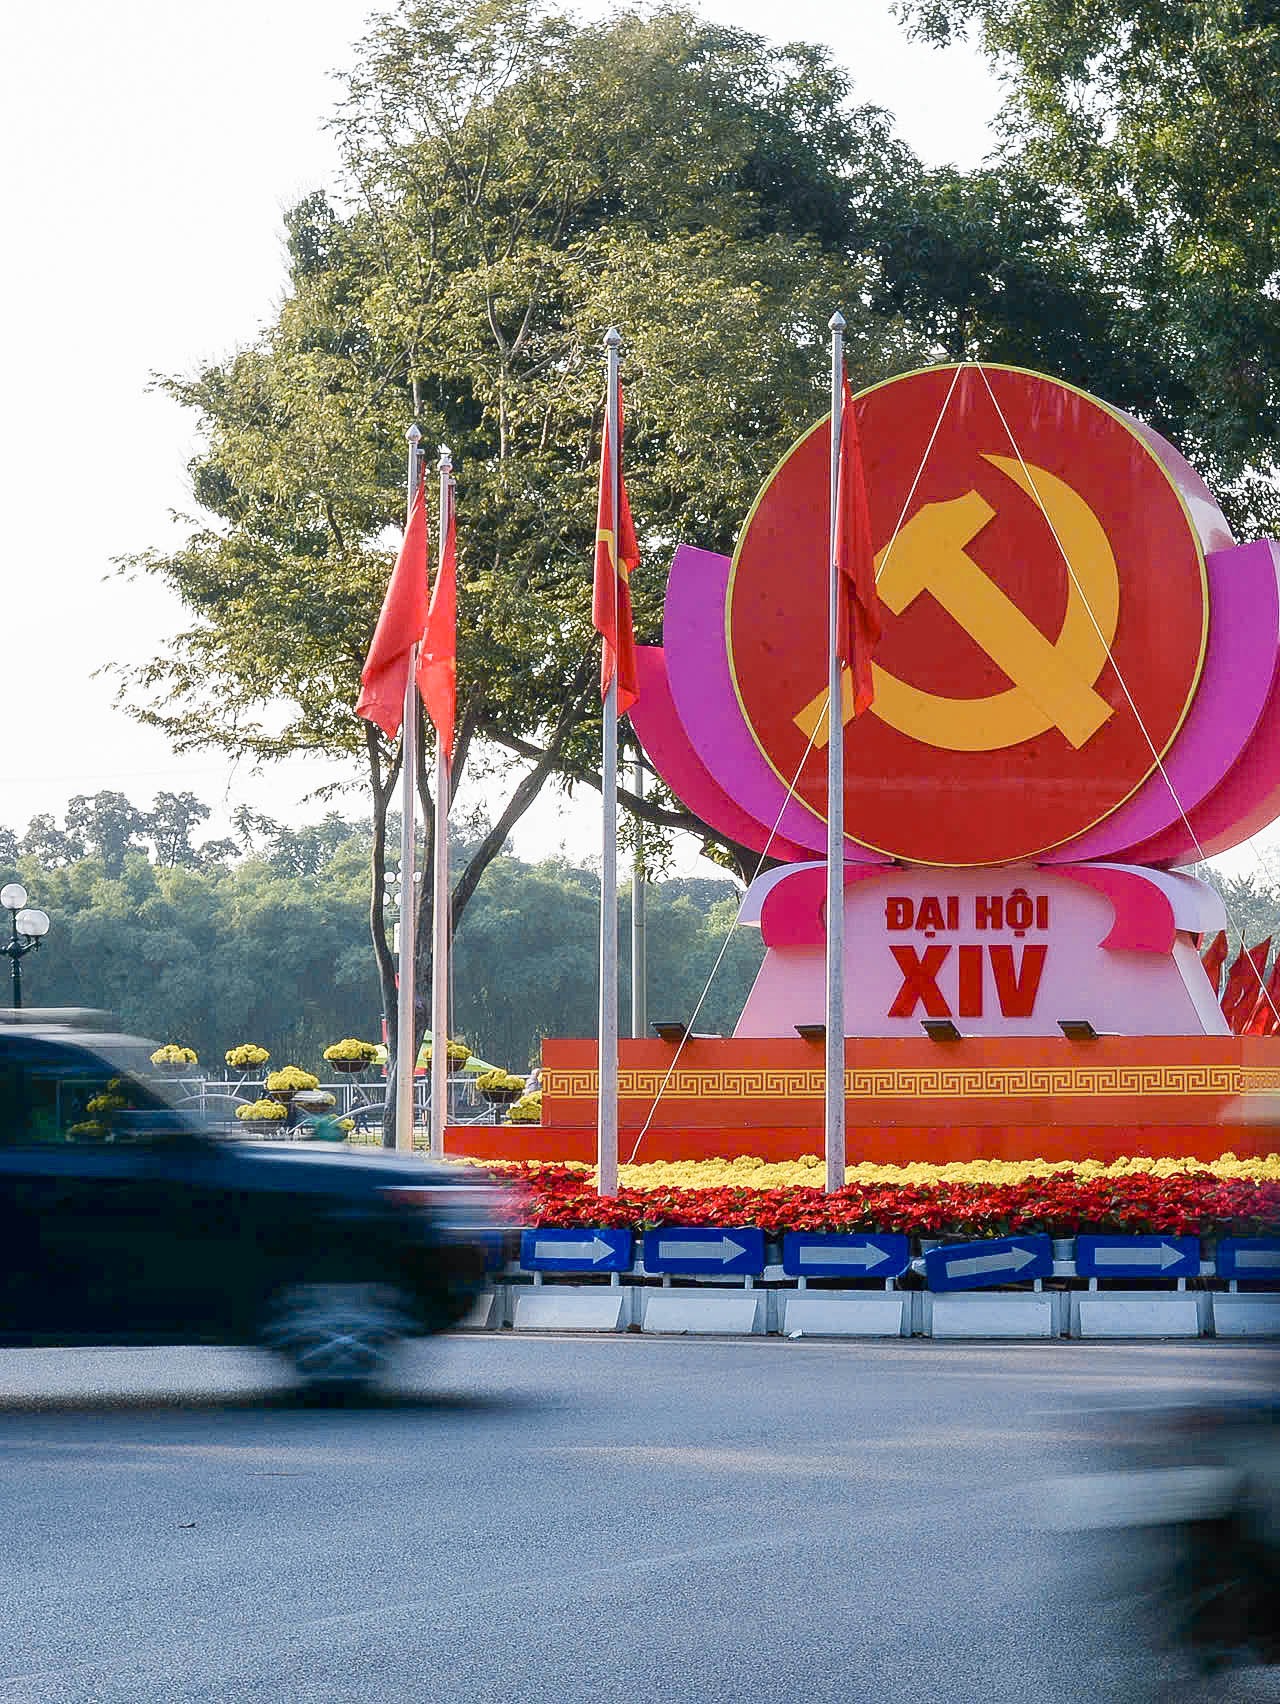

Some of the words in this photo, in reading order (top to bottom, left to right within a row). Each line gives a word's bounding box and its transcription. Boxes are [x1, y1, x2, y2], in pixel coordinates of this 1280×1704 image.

[885, 896, 959, 937] ĐẠI
[975, 888, 1048, 936] HỘI
[887, 945, 1048, 1017] XIV
